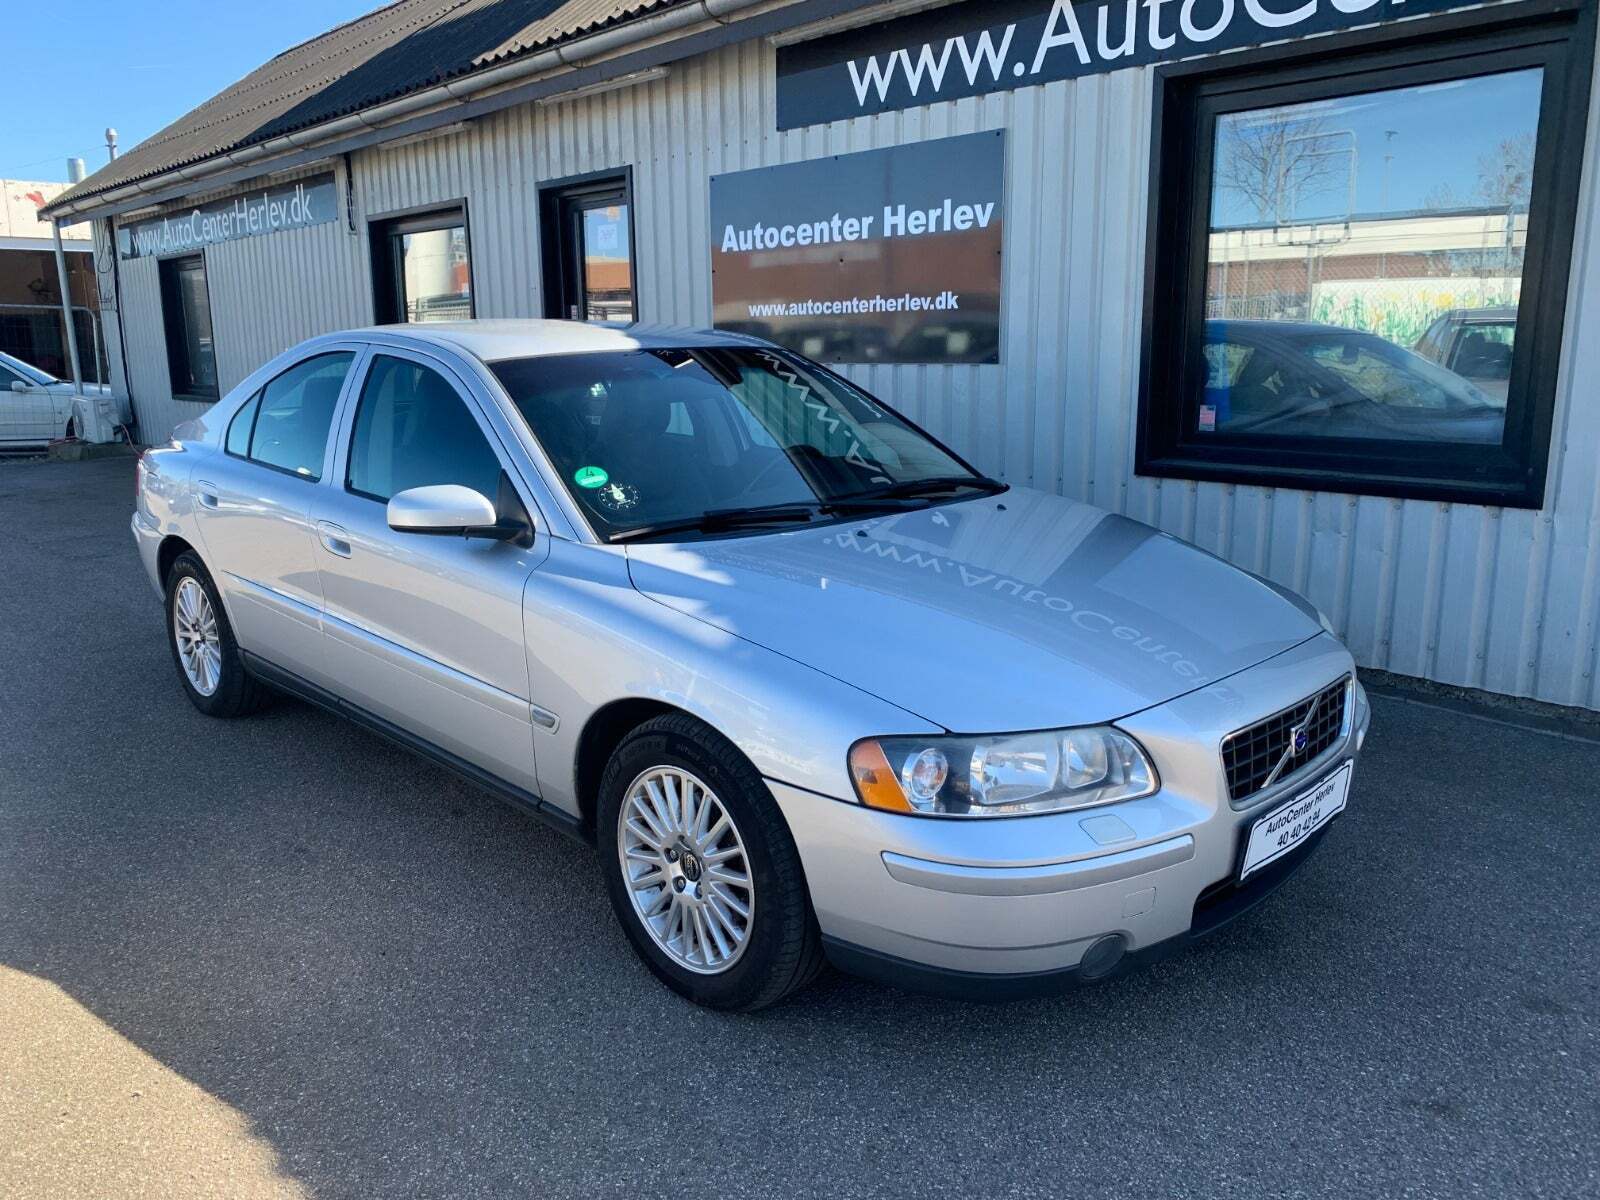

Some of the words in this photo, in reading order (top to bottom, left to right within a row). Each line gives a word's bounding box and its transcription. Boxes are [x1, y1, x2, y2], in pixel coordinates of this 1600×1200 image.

[132, 183, 313, 251] www.AutoCenterHerlev.dk
[721, 212, 875, 253] Autocenter
[883, 198, 995, 237] Herlev
[748, 291, 960, 318] www.autocenterherlev.dk
[1265, 799, 1314, 837] AutoCenter
[1277, 830, 1289, 847] 40
[1290, 823, 1302, 840] 40
